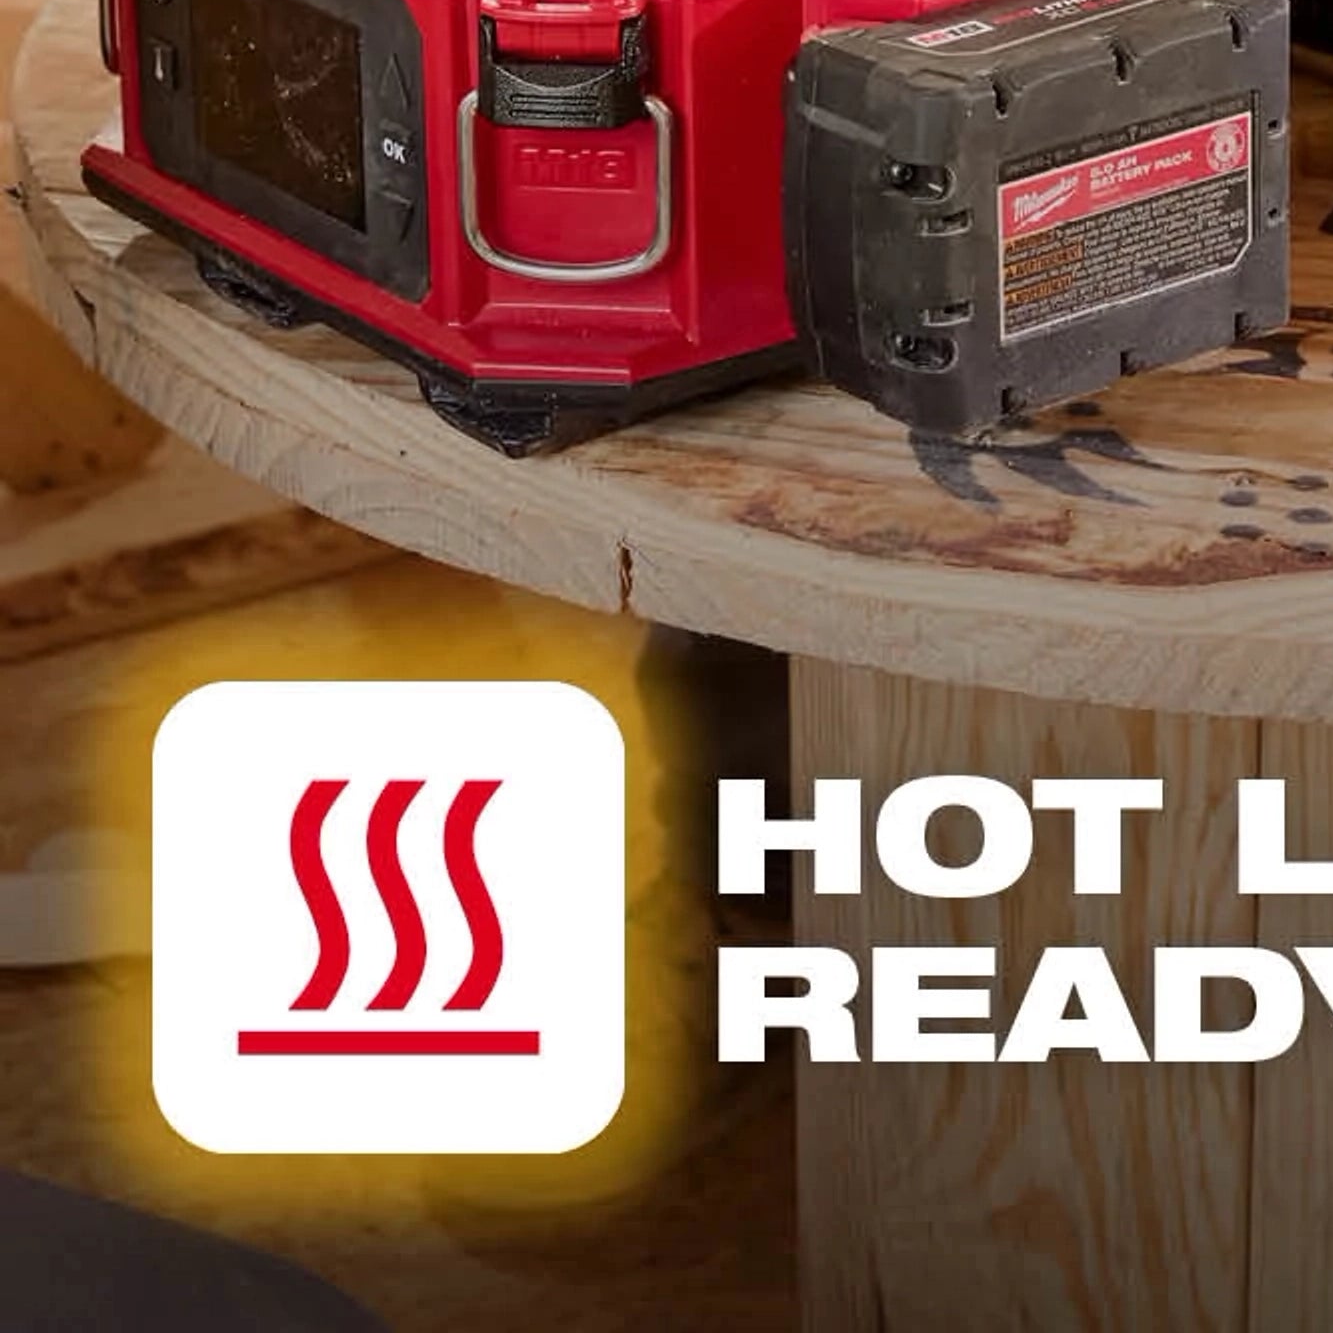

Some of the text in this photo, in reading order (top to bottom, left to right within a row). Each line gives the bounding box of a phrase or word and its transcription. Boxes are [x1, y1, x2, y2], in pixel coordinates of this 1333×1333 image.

[383, 137, 406, 165] OK
[1090, 162, 1153, 192] BATTERY
[1154, 150, 1193, 171] PACK
